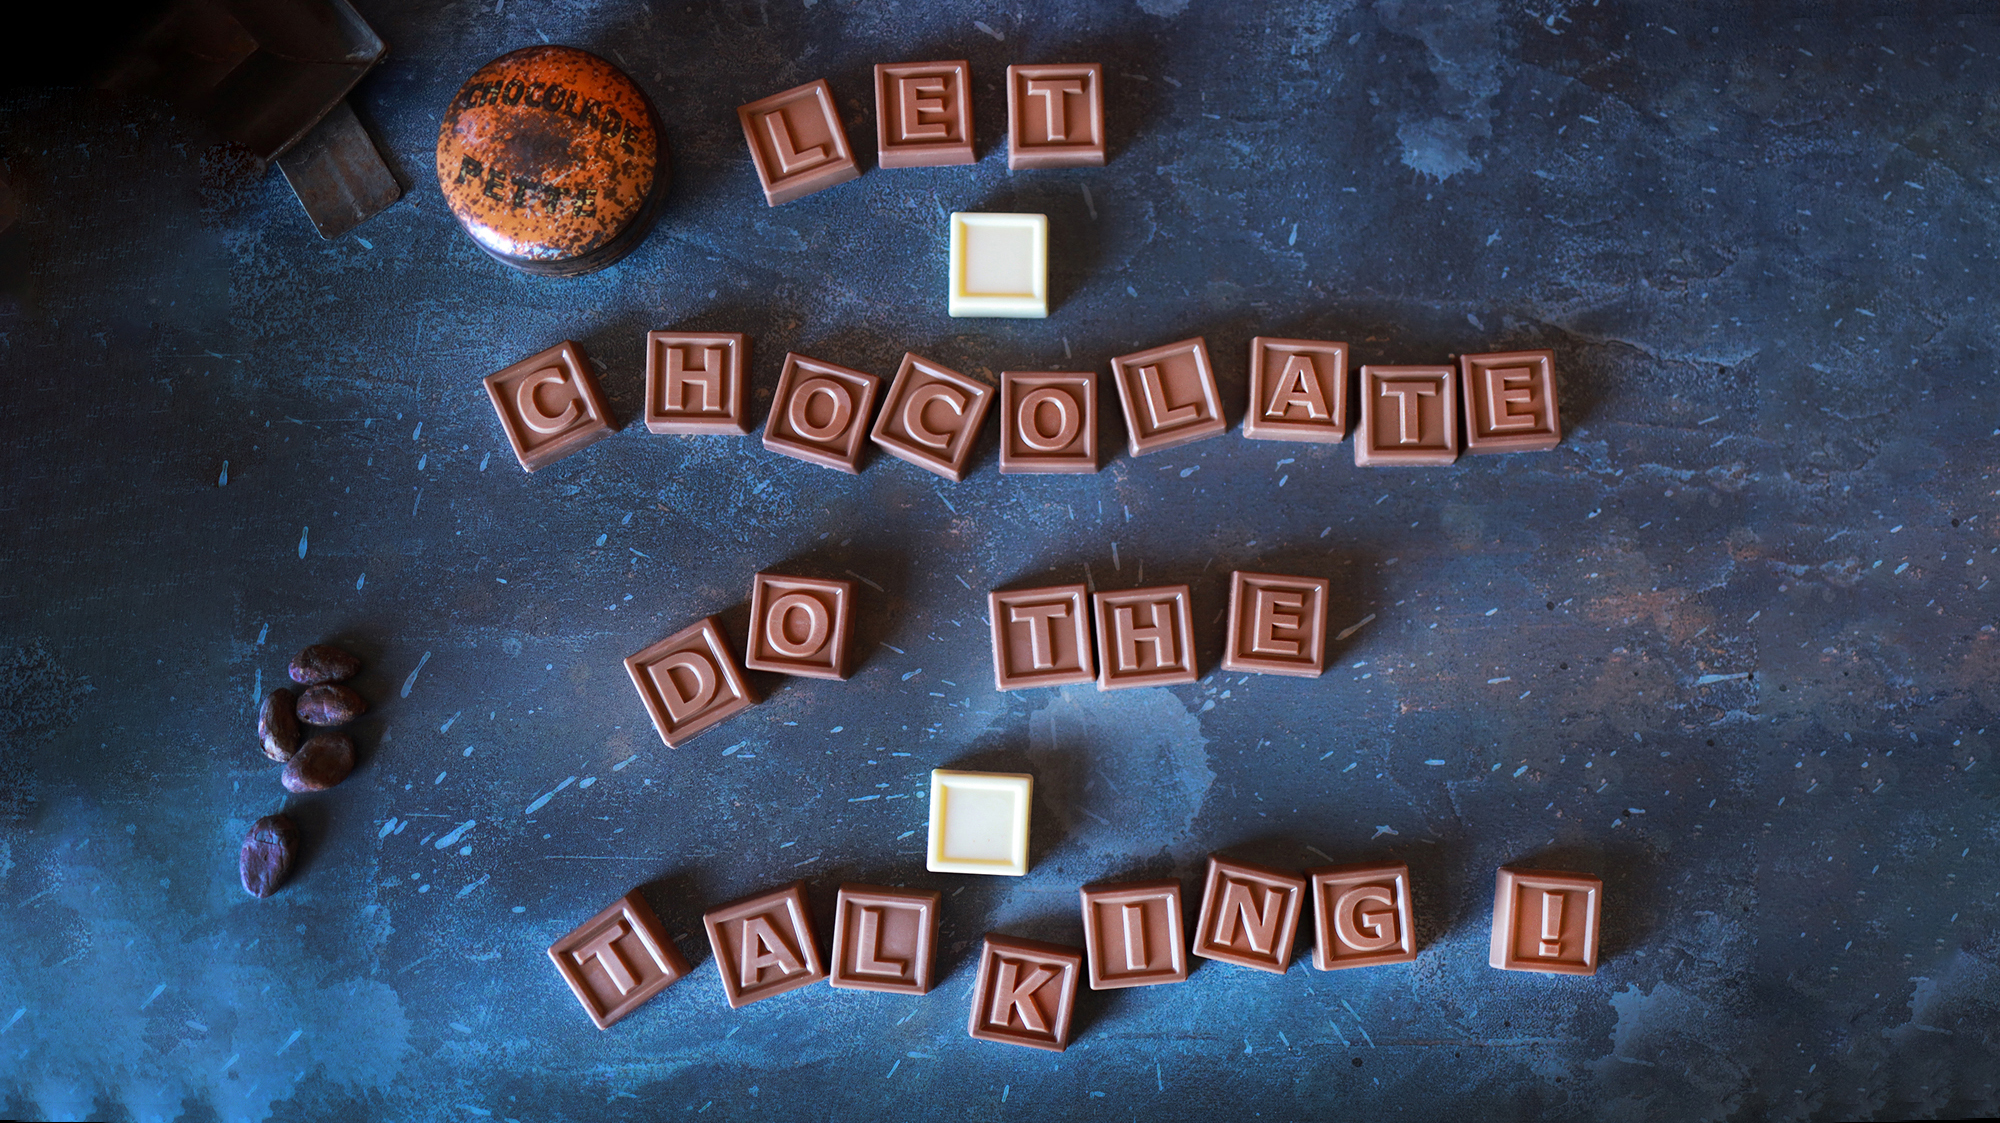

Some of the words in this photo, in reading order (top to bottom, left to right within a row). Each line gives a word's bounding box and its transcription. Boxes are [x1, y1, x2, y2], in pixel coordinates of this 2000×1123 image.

[464, 77, 645, 155] CHOCOLADE
[764, 76, 1083, 174] LET
[516, 346, 1536, 451] CHOCOLATE
[648, 590, 833, 723] DO
[1010, 588, 1304, 670] THE
[572, 878, 1398, 1034] TALKING
